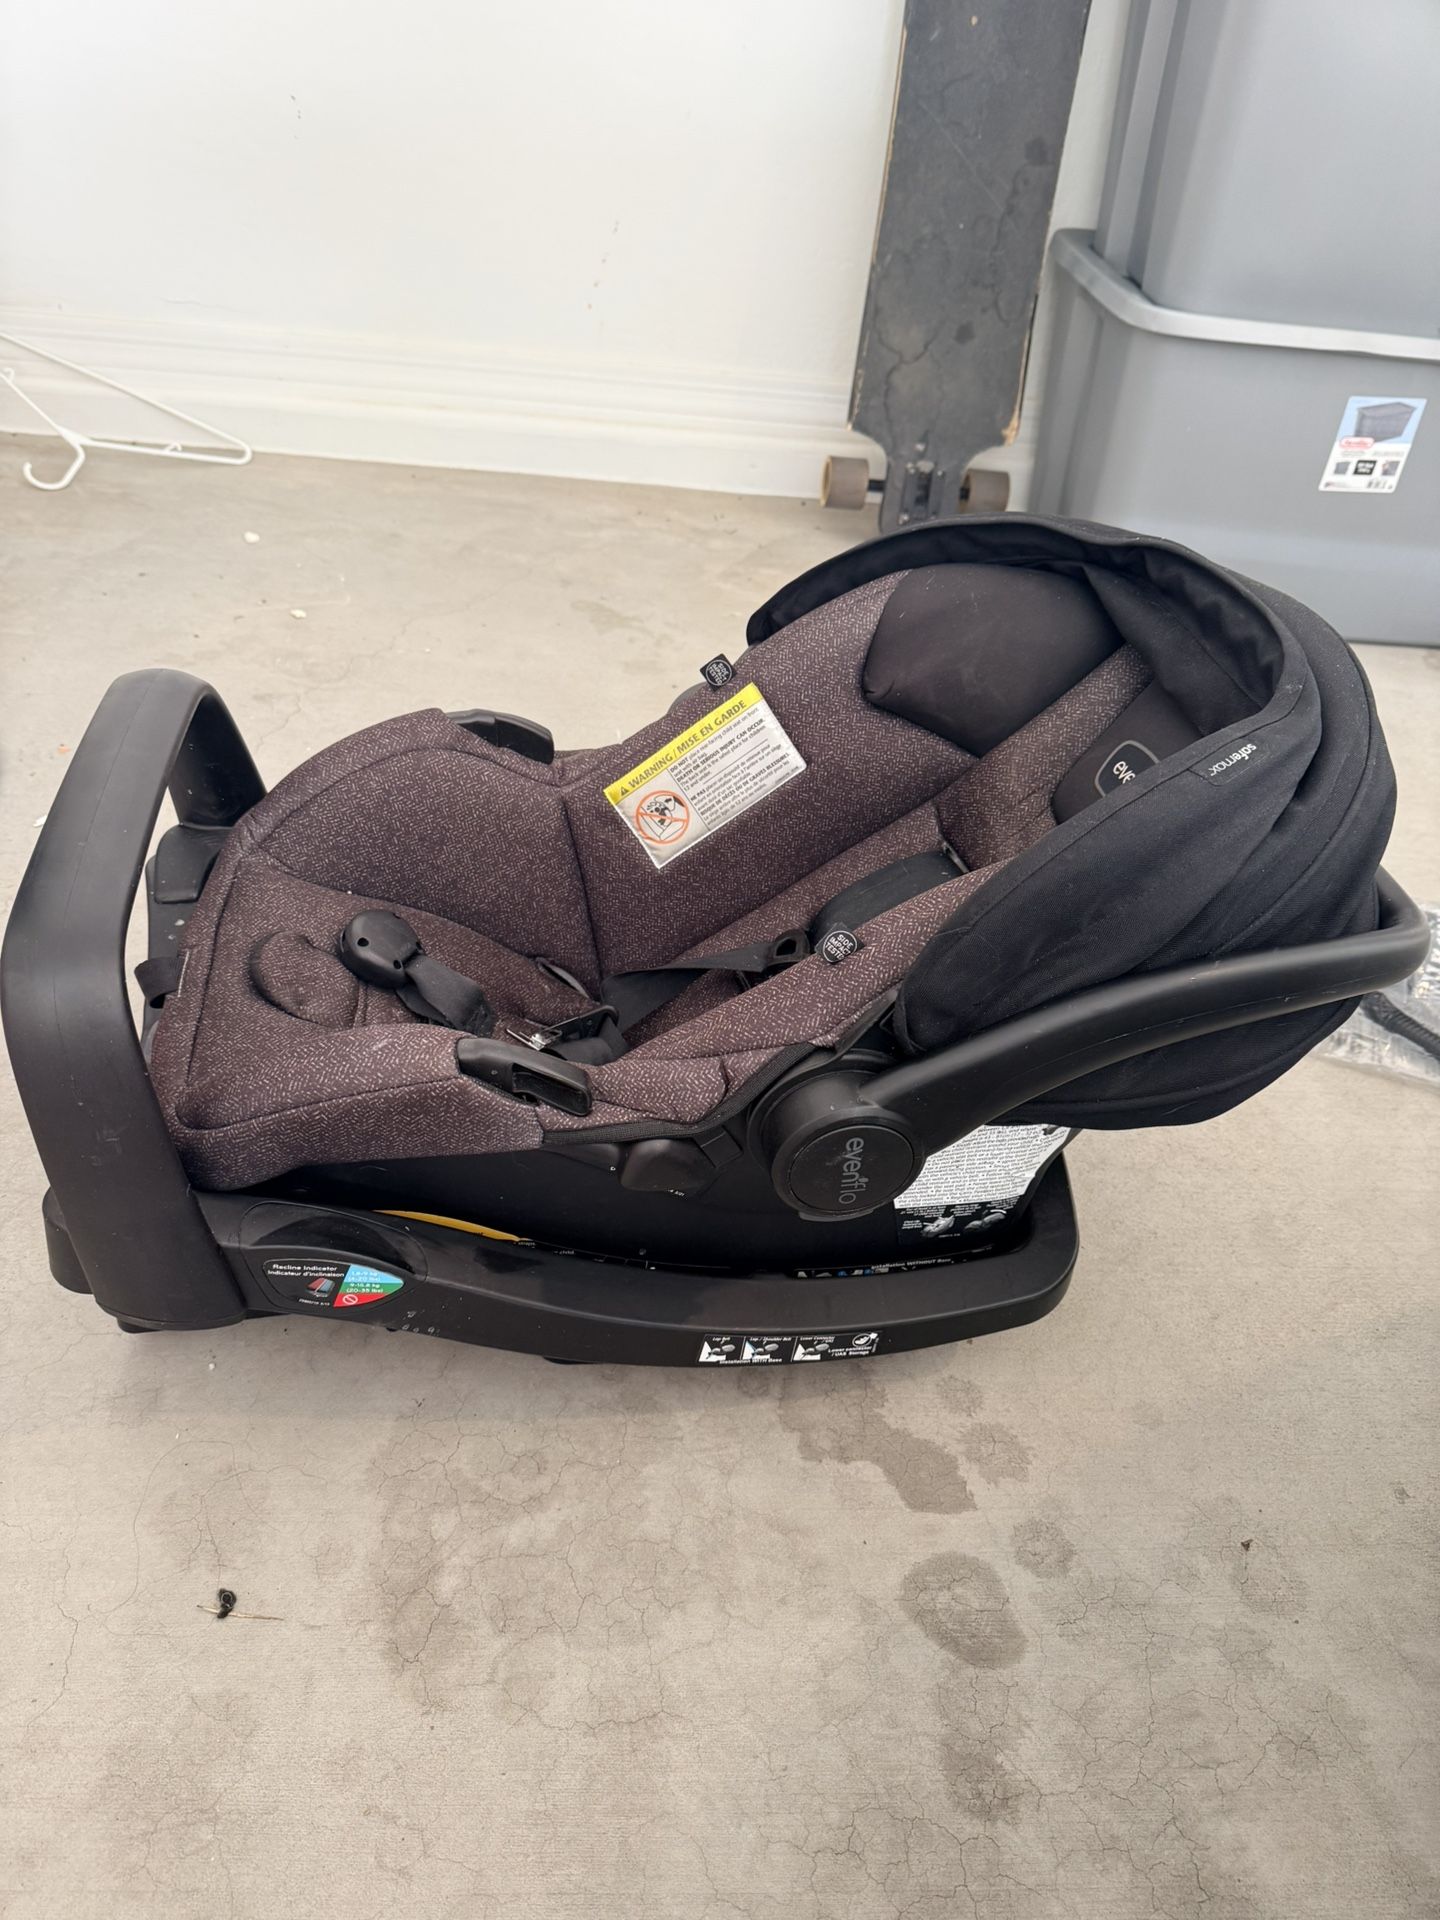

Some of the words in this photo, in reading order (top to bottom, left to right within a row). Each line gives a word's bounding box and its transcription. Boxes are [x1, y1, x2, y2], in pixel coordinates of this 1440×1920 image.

[627, 752, 673, 789] WARNING
[670, 749, 678, 758] /
[675, 732, 700, 754] MISE
[699, 723, 714, 737] EN
[712, 698, 747, 727] GARDE
[675, 767, 694, 783] DEATH
[691, 762, 701, 771] OR
[699, 748, 720, 766] SERIOUS
[718, 737, 736, 752] INJURY
[735, 729, 747, 740] CAN
[669, 764, 678, 773] DO
[677, 756, 689, 767] NOT
[1208, 743, 1257, 777] safemax
[695, 788, 706, 797] PAS
[829, 936, 851, 955] IMPACT
[837, 934, 854, 949] SIDE
[838, 1137, 866, 1204] evenflo
